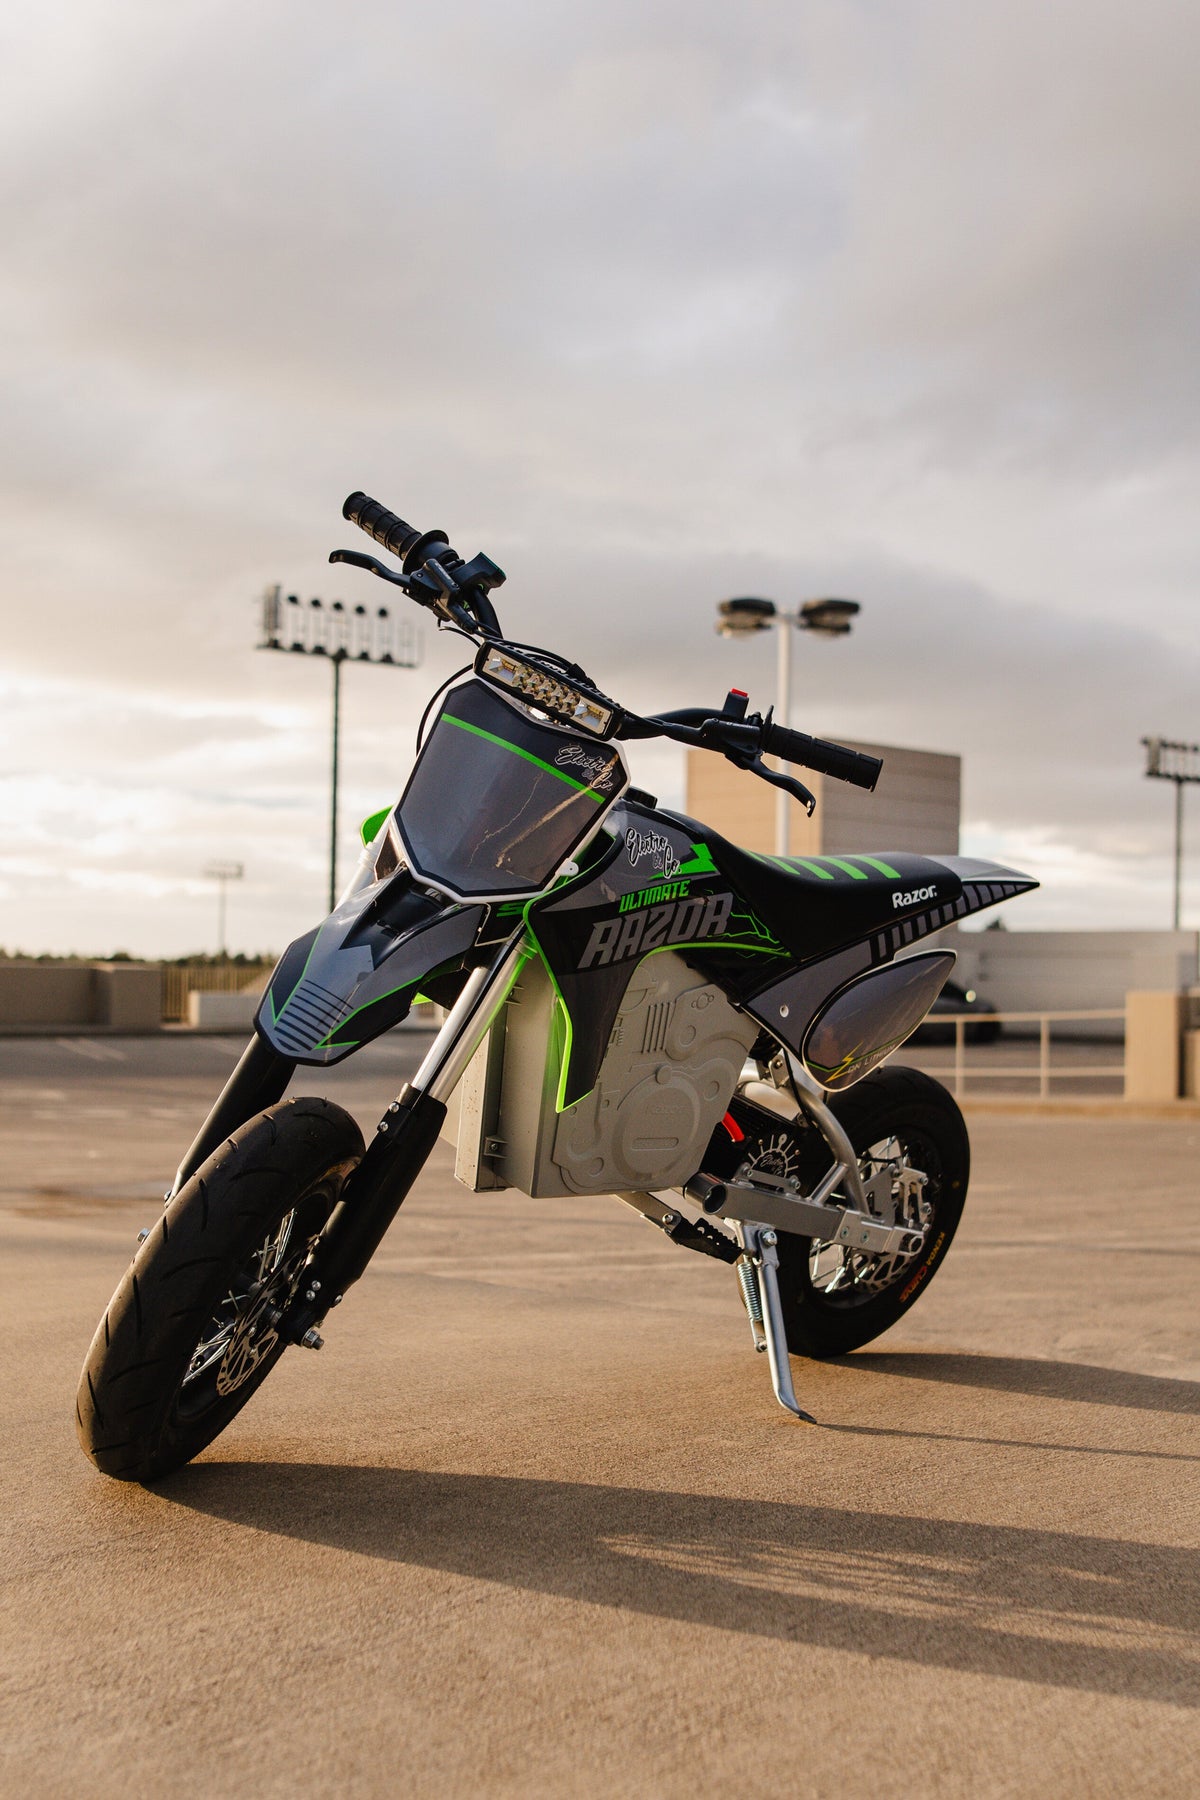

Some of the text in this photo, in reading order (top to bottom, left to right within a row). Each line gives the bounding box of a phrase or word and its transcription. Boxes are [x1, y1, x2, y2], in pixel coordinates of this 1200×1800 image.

[555, 745, 613, 772] Electro
[625, 827, 668, 867] Electro
[663, 844, 682, 879] Co.
[619, 879, 691, 913] ULTIMATE
[577, 892, 734, 969] RAZOR
[926, 1231, 945, 1266] KENDA
